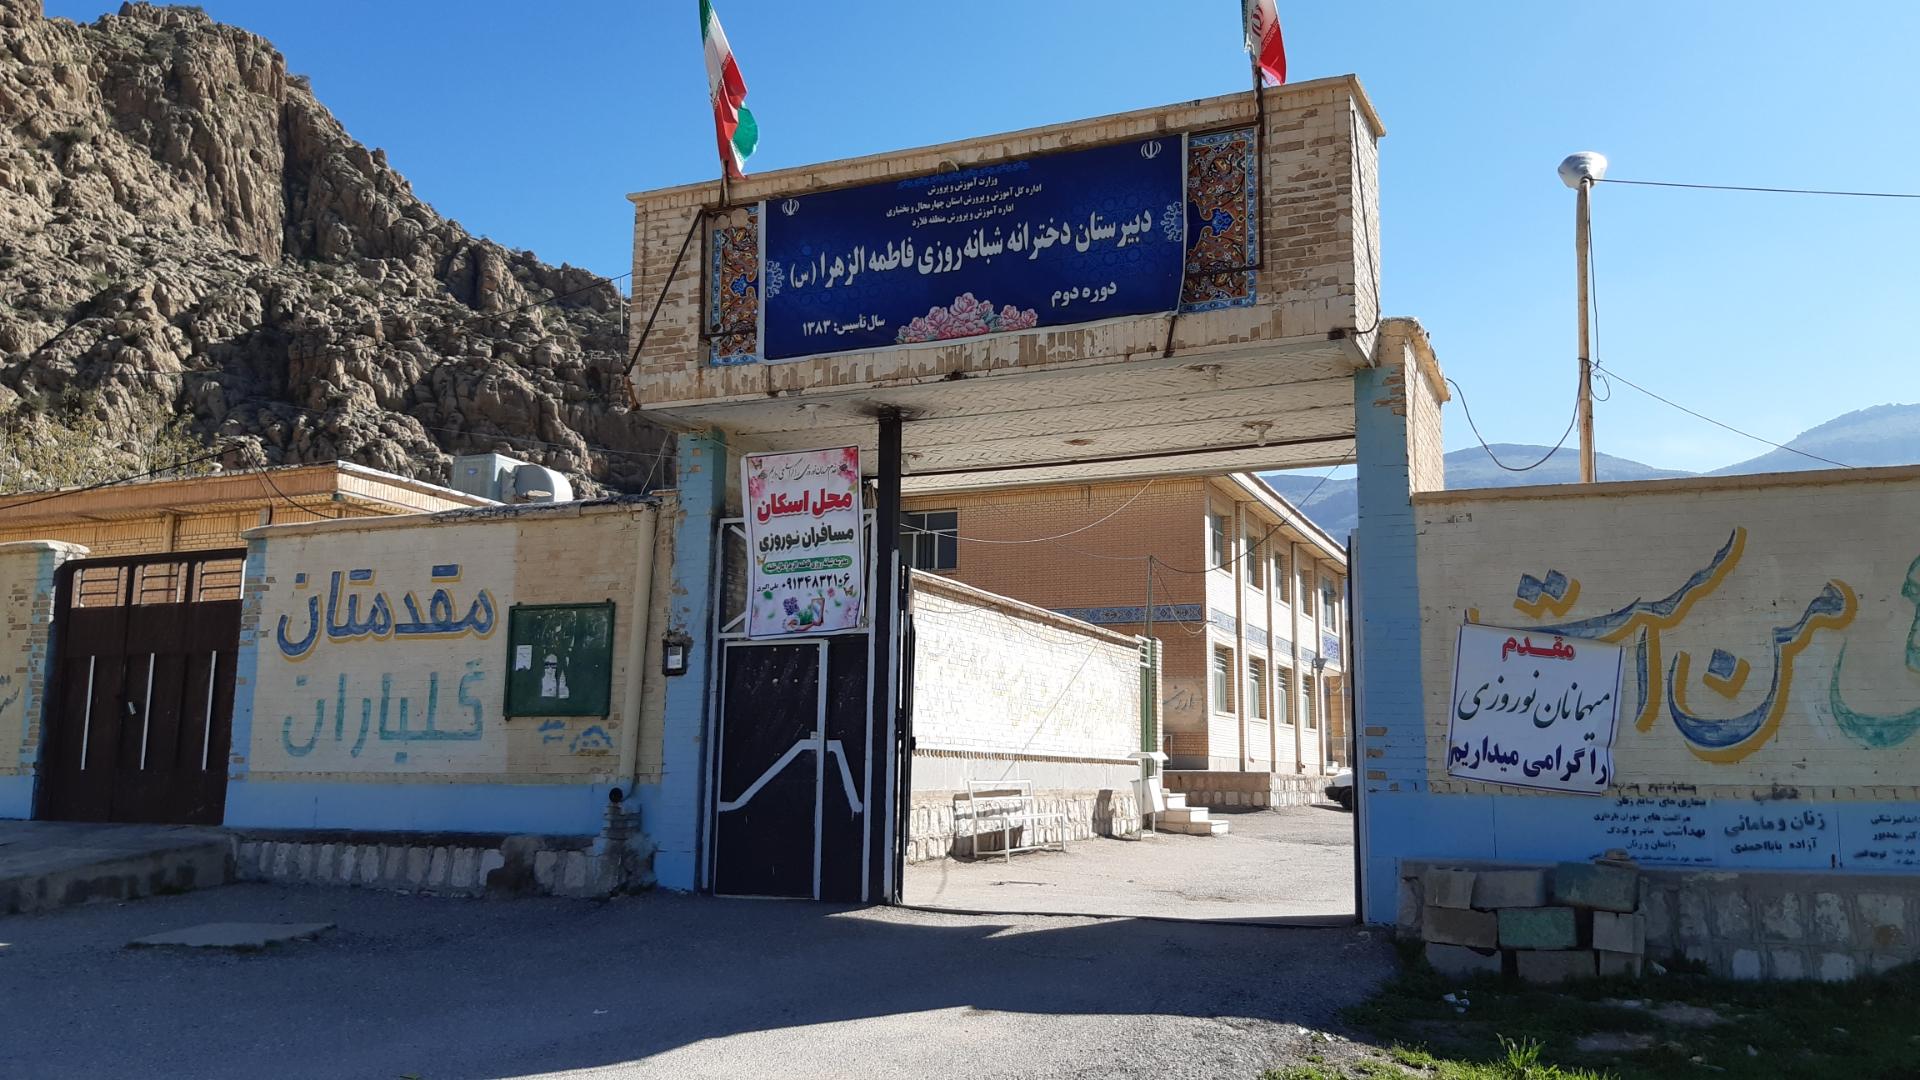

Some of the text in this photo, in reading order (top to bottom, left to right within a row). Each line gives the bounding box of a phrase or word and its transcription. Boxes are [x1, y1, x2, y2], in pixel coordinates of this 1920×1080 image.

[954, 177, 978, 191] آموزش
[978, 176, 998, 187] وزارت
[927, 184, 950, 196] پرورش
[990, 187, 1014, 201] آموزش
[1014, 186, 1024, 198] کل
[1025, 184, 1042, 196] اداره
[945, 196, 963, 208] استان
[964, 194, 986, 206] پرورش
[886, 205, 910, 217] بختیاری
[947, 211, 969, 224] پرورش
[974, 205, 998, 219] آموزش
[998, 204, 1014, 216] اداره
[912, 215, 928, 228] فلارد
[928, 215, 946, 224] منطقه
[1007, 217, 1071, 260] دخترانه
[1075, 209, 1152, 253] دبیرستان
[868, 236, 914, 272] فاطمه
[820, 245, 865, 288] الزهرا
[1051, 281, 1117, 307] دوره دوم
[802, 320, 831, 337] ۱۳۸۳
[866, 314, 886, 331] سال
[757, 487, 853, 522] محل اسکان
[759, 522, 854, 552] مسافران نوروزی
[1502, 635, 1576, 662] مقدم
[1457, 670, 1540, 720] نوروزی
[1523, 744, 1585, 782] گرامی
[1590, 747, 1608, 785] را
[1778, 816, 1786, 832] و
[1790, 809, 1826, 831] زنان
[1789, 836, 1818, 852] آزاده
